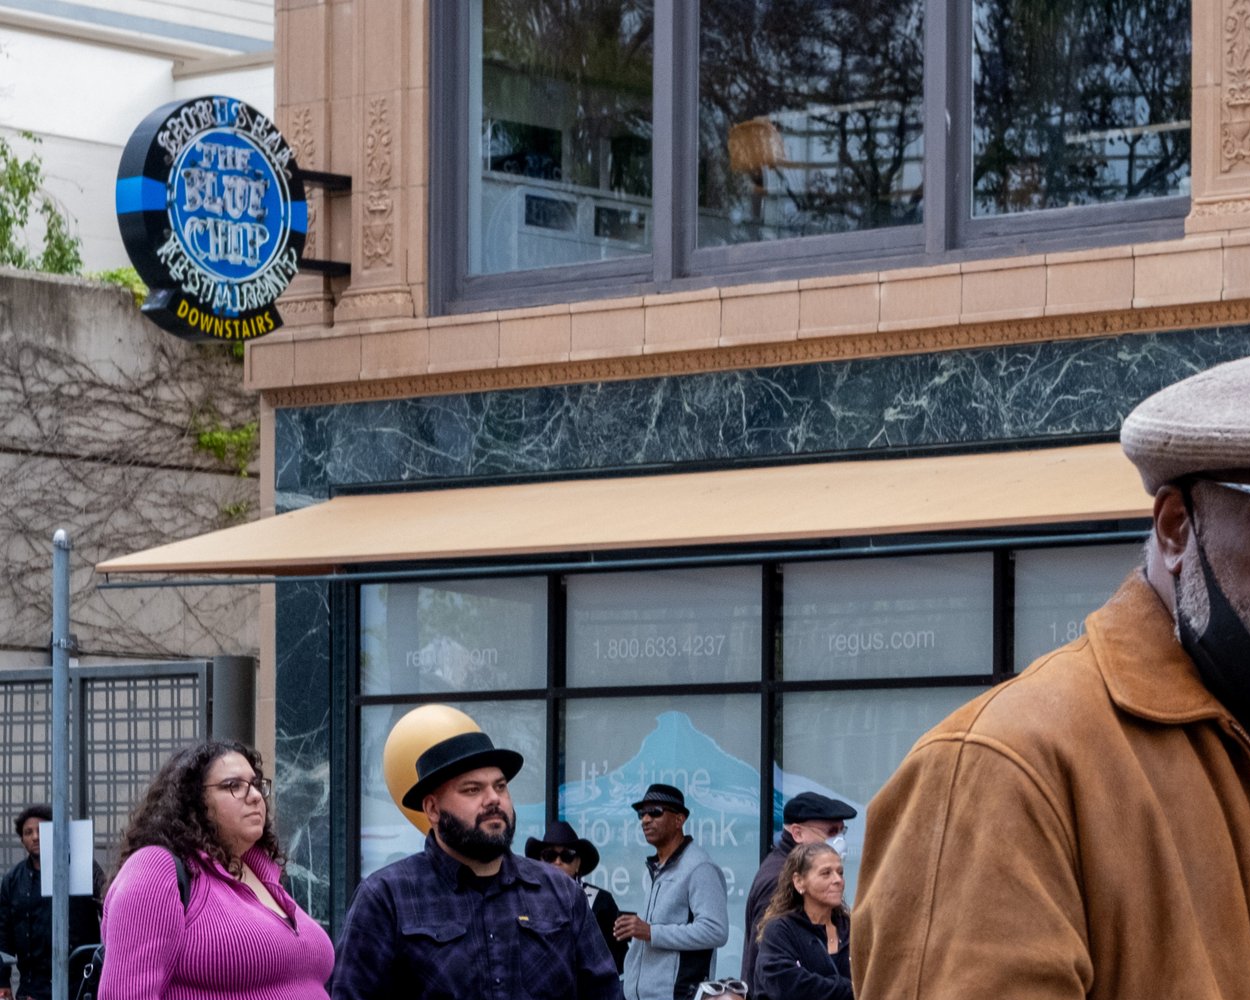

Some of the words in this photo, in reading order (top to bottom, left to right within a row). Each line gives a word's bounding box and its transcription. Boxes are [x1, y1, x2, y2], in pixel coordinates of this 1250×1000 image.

[158, 101, 248, 162] SPORTS
[250, 115, 297, 180] BAR
[196, 141, 254, 172] THE
[181, 168, 270, 219] BLUE
[184, 217, 270, 267] CHIP
[157, 232, 299, 312] RESTAURANT
[176, 299, 275, 339] DOWNSTAIRS
[593, 634, 726, 660] 1.800.633.4237
[828, 630, 935, 656] regus.com
[578, 810, 611, 847] to
